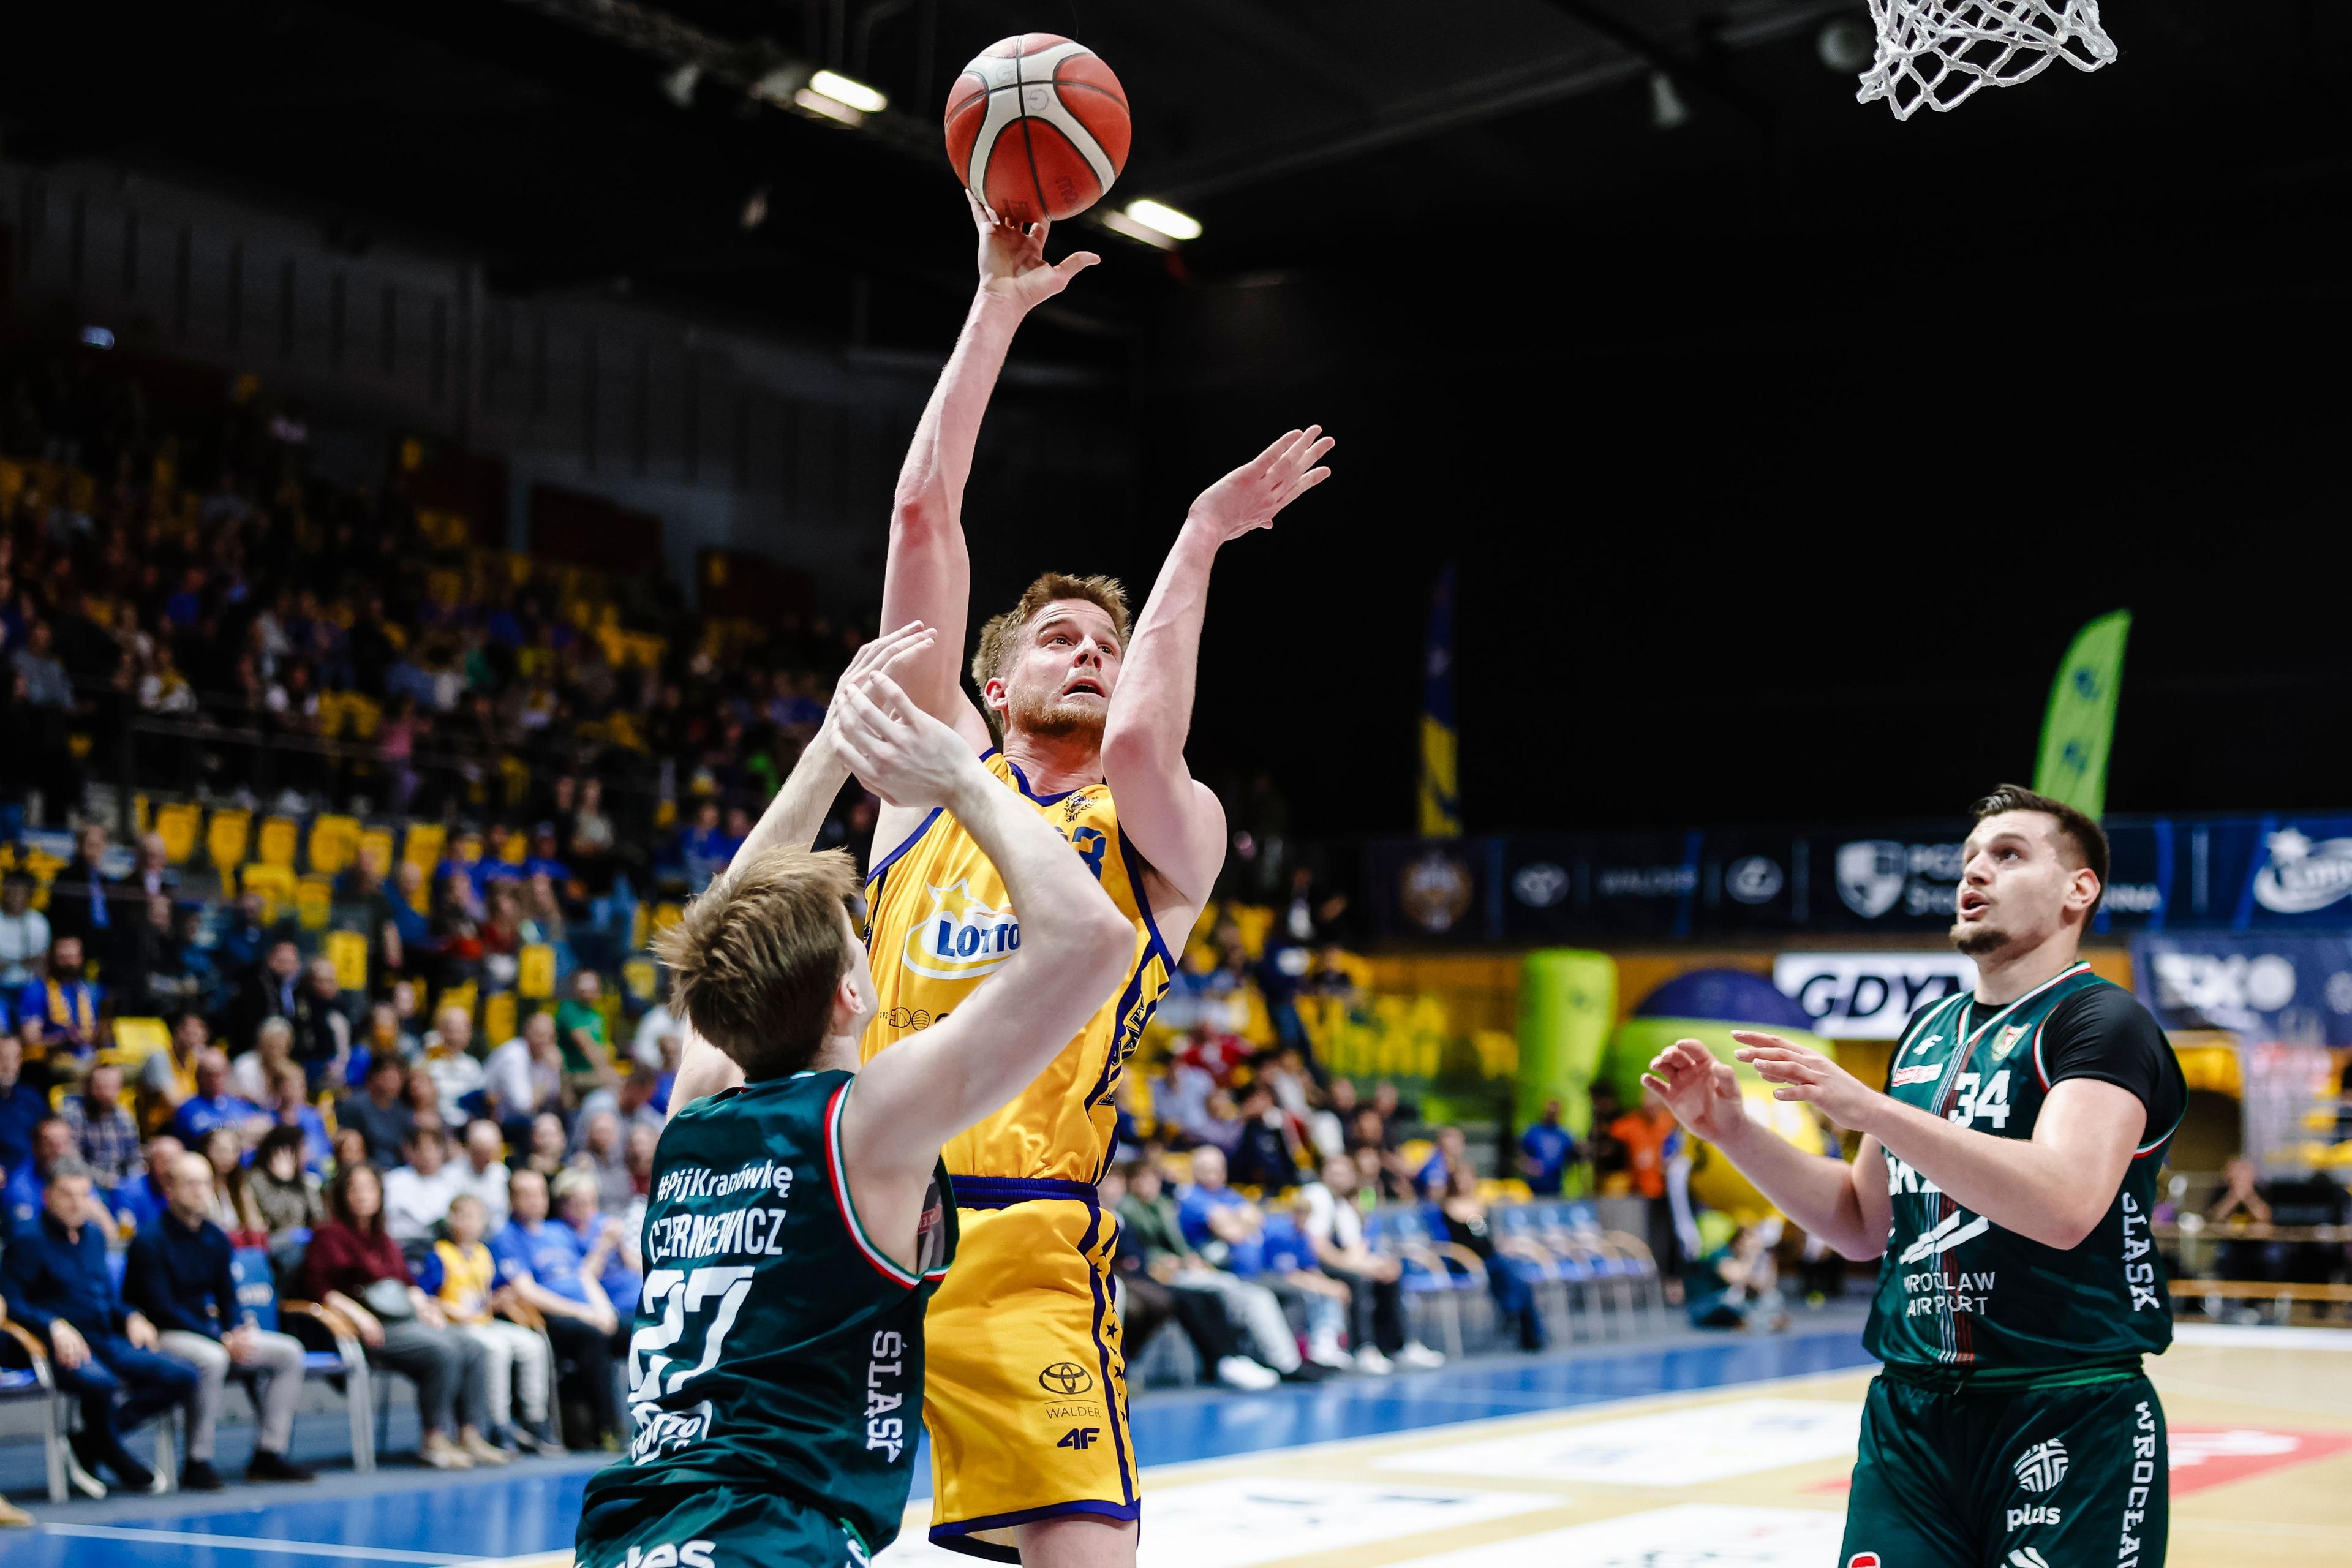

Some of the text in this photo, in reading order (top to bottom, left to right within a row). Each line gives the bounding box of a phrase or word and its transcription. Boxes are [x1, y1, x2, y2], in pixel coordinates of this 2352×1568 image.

[1055, 826, 1106, 882] 3
[937, 919, 1021, 957] LOTTO
[1948, 1069, 2011, 1129] 34
[1906, 1294, 1989, 1318] AIRPORT
[627, 1265, 756, 1403] 27
[1046, 1406, 1102, 1419] WALDER
[1056, 1427, 1101, 1450] 4F
[2006, 1502, 2062, 1532] plus
